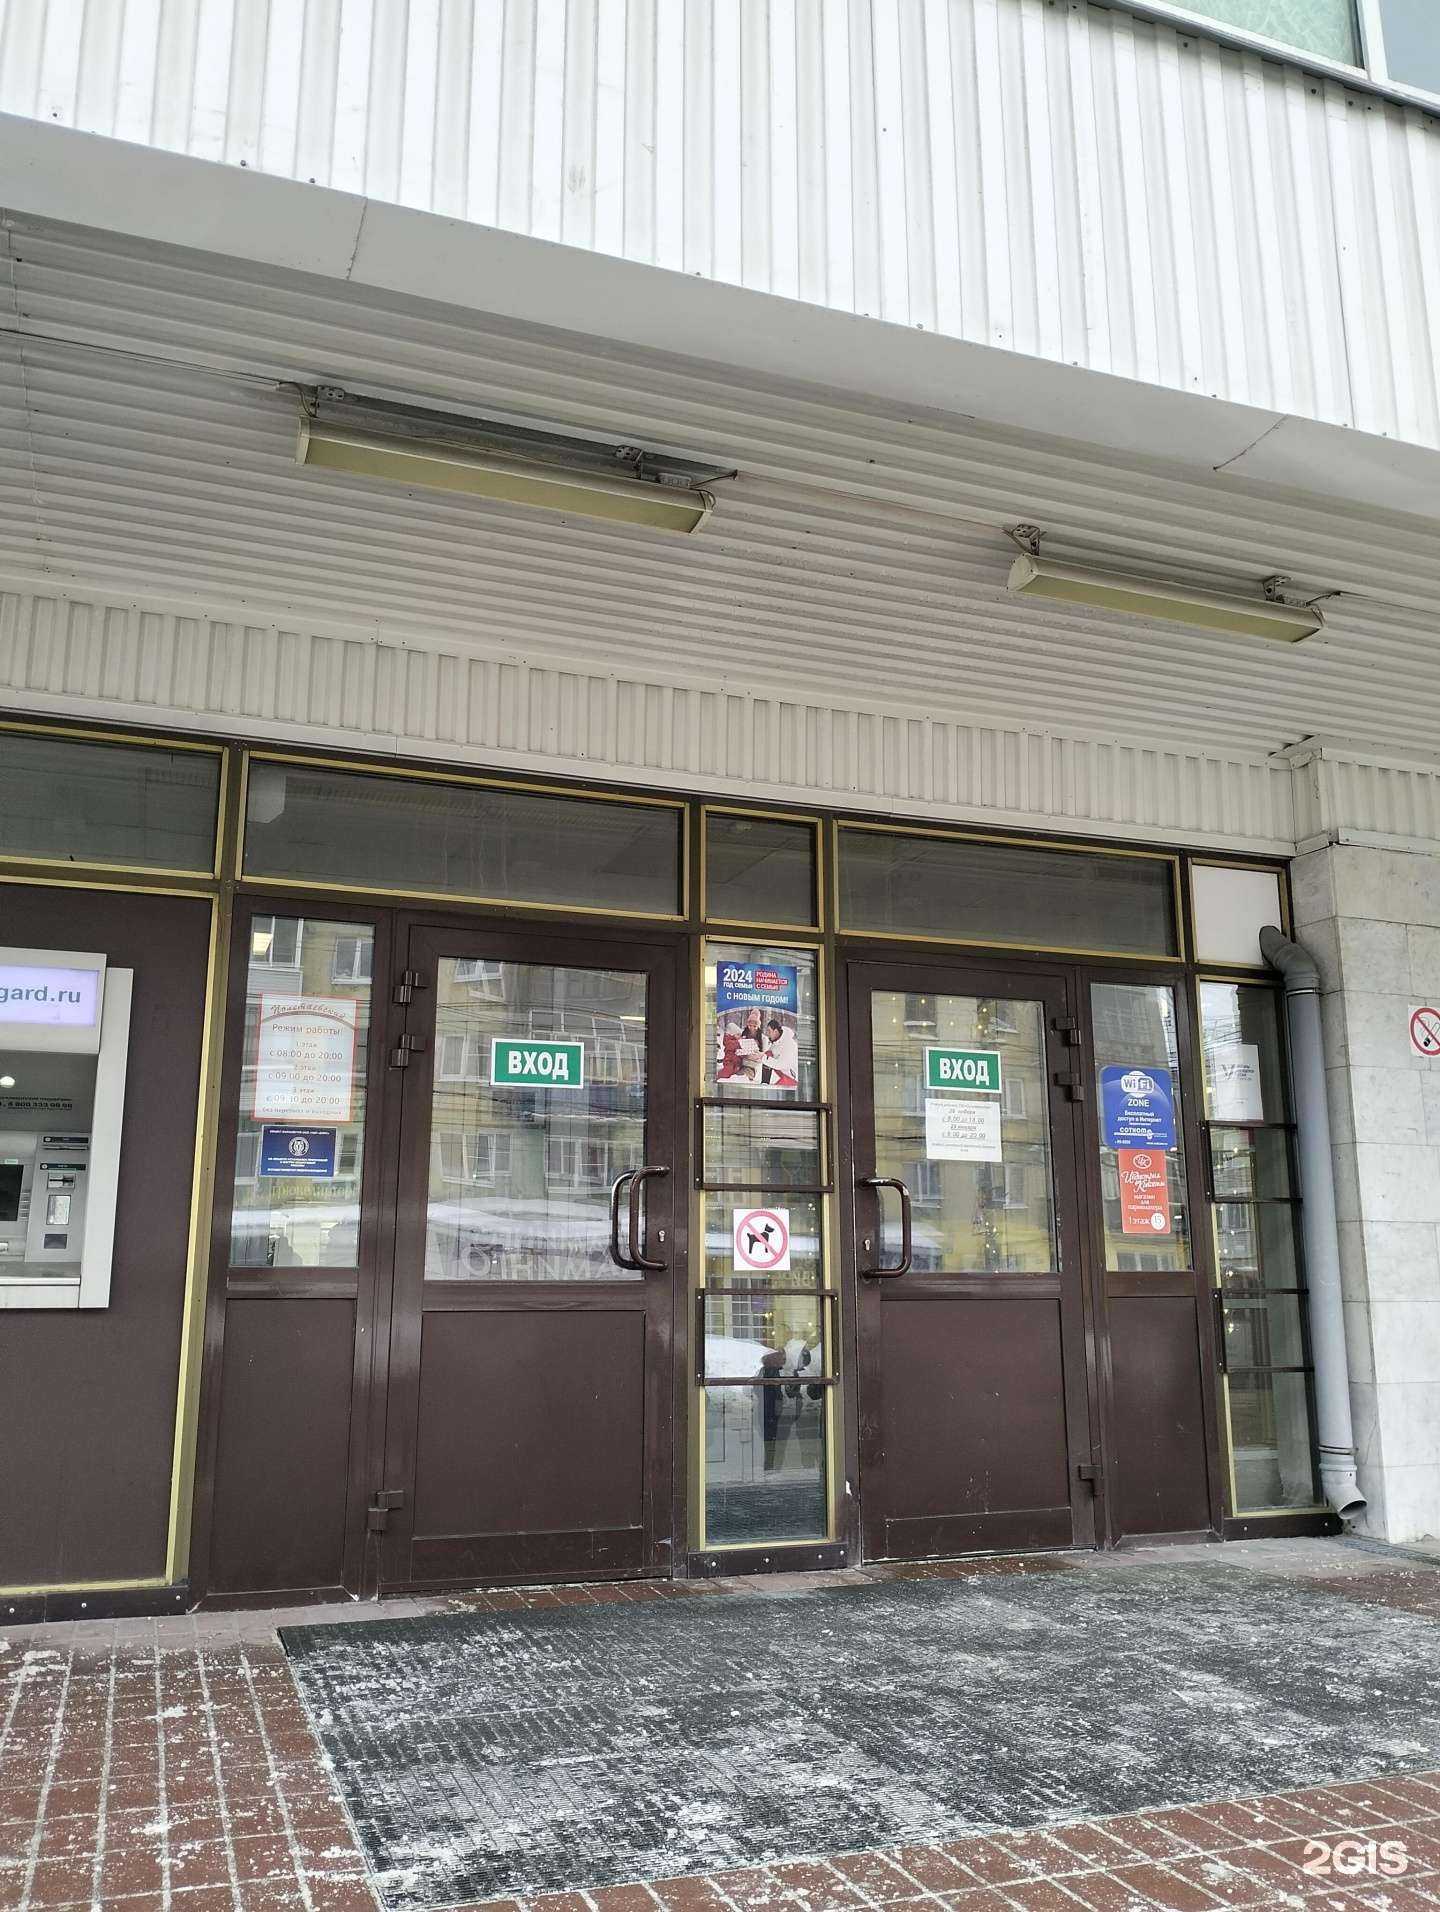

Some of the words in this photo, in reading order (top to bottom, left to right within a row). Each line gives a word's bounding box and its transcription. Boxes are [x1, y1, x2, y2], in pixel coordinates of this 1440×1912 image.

[723, 968, 753, 983] 2024
[755, 971, 777, 979] РОДИНА
[726, 991, 732, 1000] С
[733, 992, 761, 1001] НОВЫМ
[762, 994, 789, 1004] ГОДОМ!
[272, 1023, 303, 1033] Режим
[304, 1051, 315, 1060] до
[508, 1050, 569, 1080] ВХОД
[939, 1057, 990, 1086] ВХОД
[303, 1074, 314, 1082] до
[301, 1097, 313, 1105] до
[1127, 1098, 1150, 1107] ZONE
